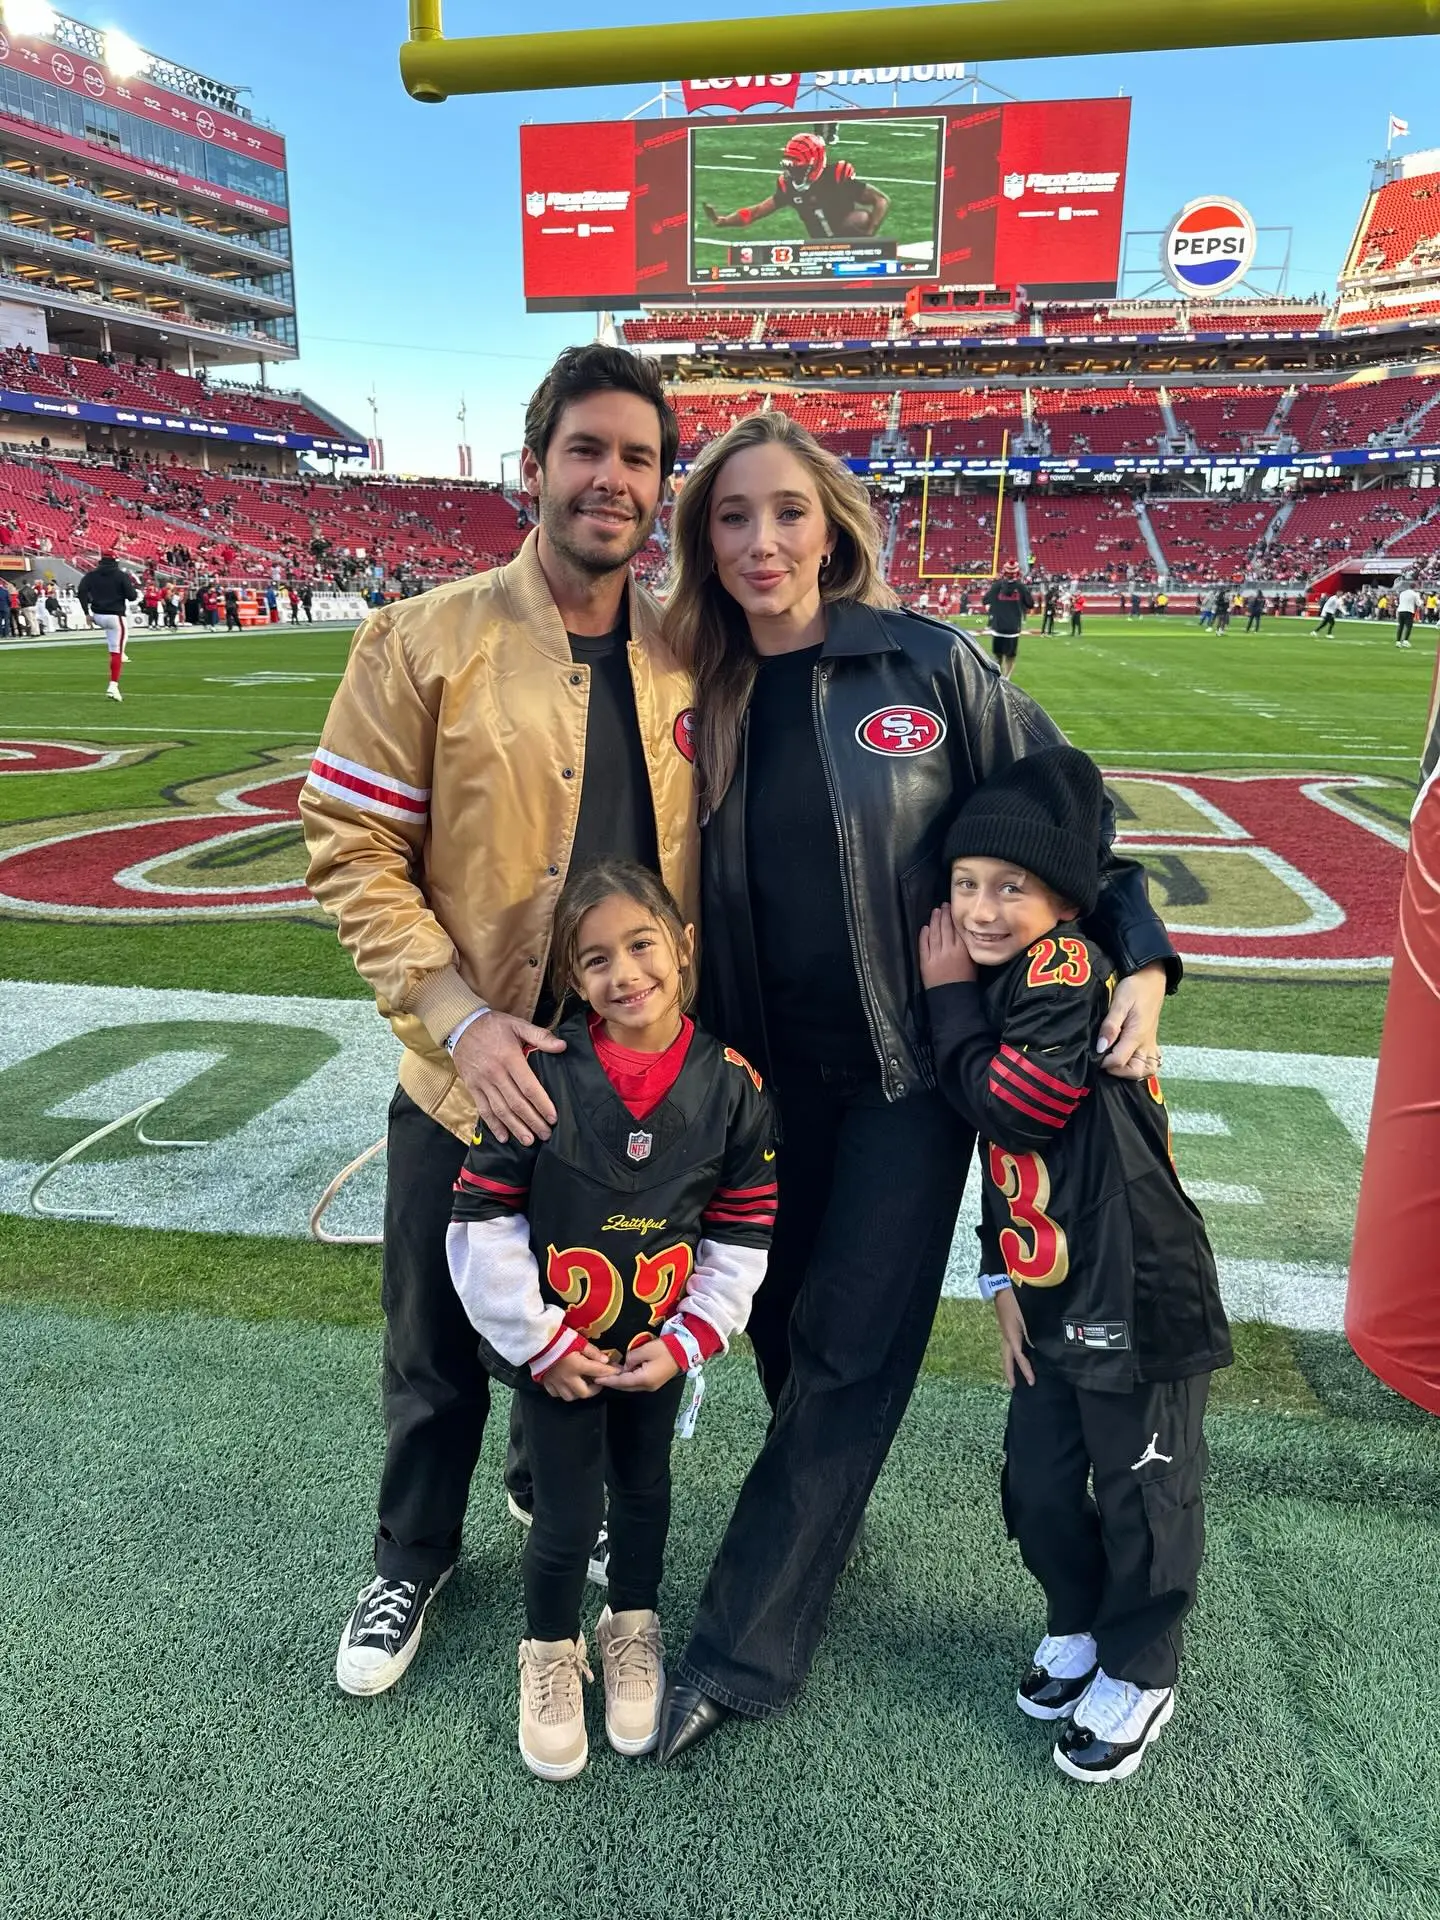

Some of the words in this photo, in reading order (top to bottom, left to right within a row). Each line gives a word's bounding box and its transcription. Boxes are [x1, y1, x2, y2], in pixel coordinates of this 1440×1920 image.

[815, 62, 965, 88] STADIUM
[1174, 237, 1245, 255] PEPSI
[1093, 472, 1124, 484] xfinity
[881, 713, 930, 749] SF
[1027, 937, 1092, 988] 23
[631, 1142, 649, 1156] NFL
[601, 1214, 667, 1236] Faithful
